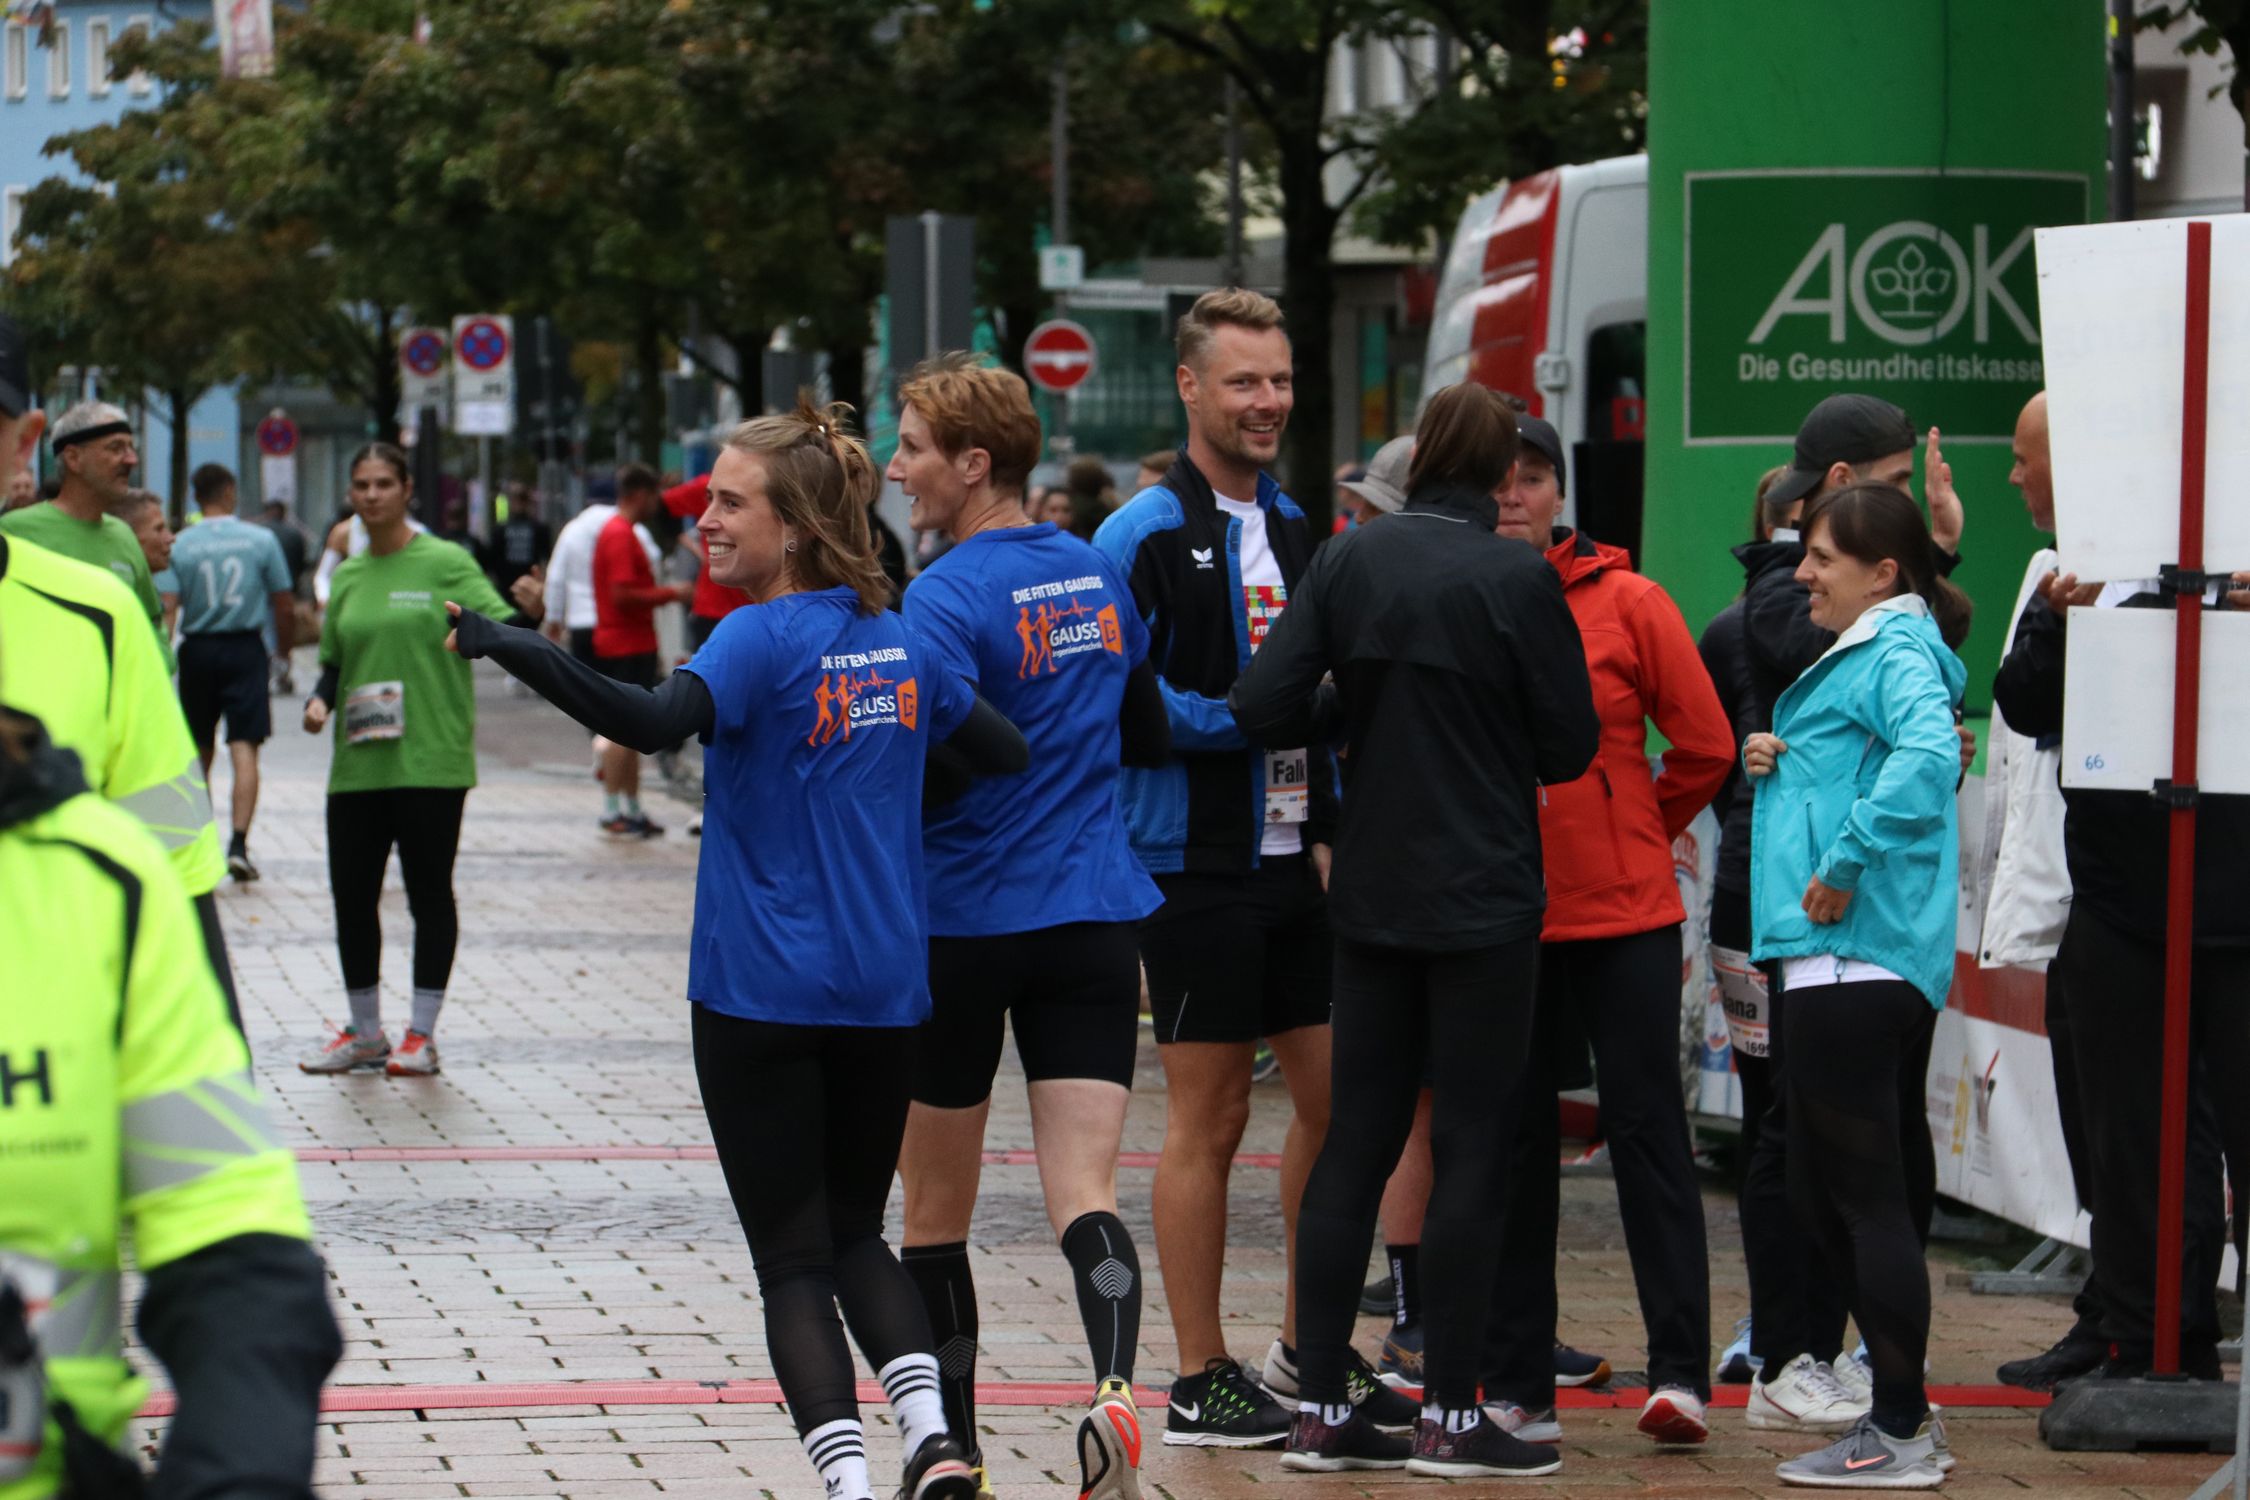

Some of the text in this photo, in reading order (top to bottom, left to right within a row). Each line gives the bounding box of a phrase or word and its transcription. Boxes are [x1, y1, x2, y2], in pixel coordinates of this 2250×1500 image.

[1746, 220, 2041, 346] AOK
[1739, 352, 2043, 382] Die Gesundheitskasse
[198, 556, 244, 609] 12
[1012, 588, 1032, 604] DIE
[1031, 581, 1065, 600] FITTEN
[1049, 621, 1101, 647] GAUSS
[849, 695, 896, 718] GUSS
[2085, 753, 2105, 770] 66
